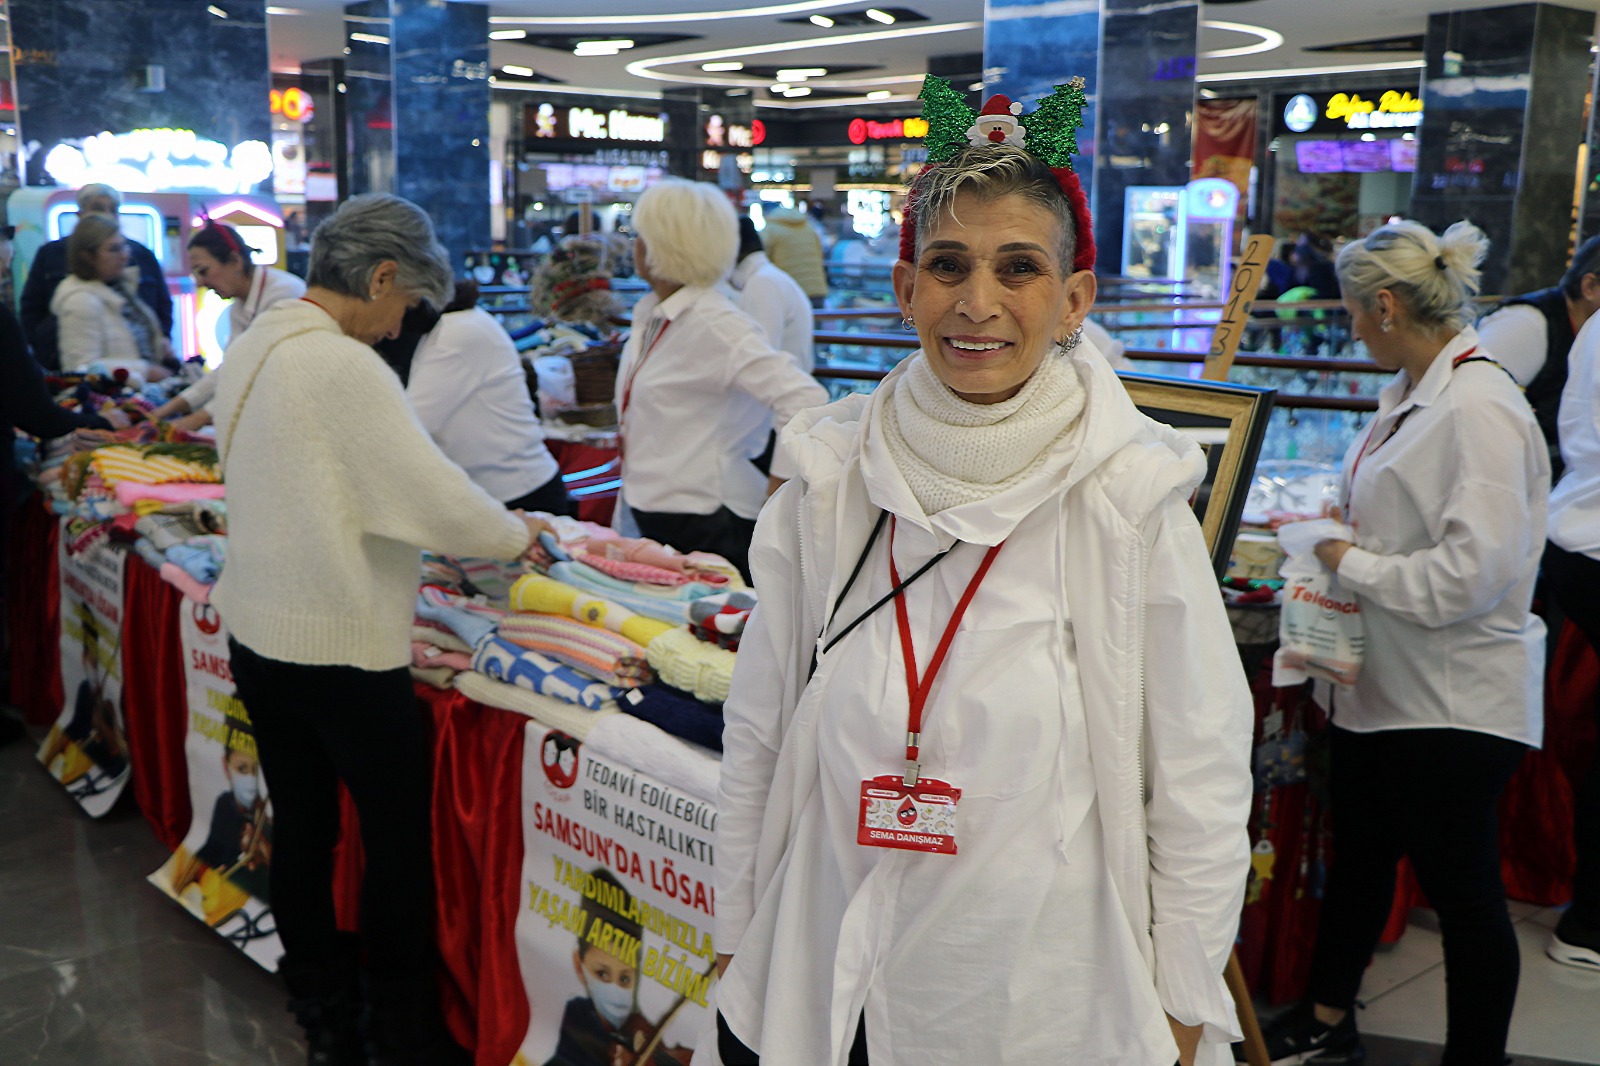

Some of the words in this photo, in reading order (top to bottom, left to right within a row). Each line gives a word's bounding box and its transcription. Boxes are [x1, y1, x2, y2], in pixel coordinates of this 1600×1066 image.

[1209, 240, 1261, 357] 2013
[583, 789, 609, 820] BİR
[585, 758, 636, 798] TEDAVİ
[534, 802, 645, 883] SAMSUN'DA
[870, 830, 895, 840] SEMA
[896, 833, 944, 845] DANIŞMAZ
[528, 880, 588, 938] YAŞAM
[585, 917, 642, 969] ARTIK
[552, 854, 717, 965] YARDIMLARINIZLA
